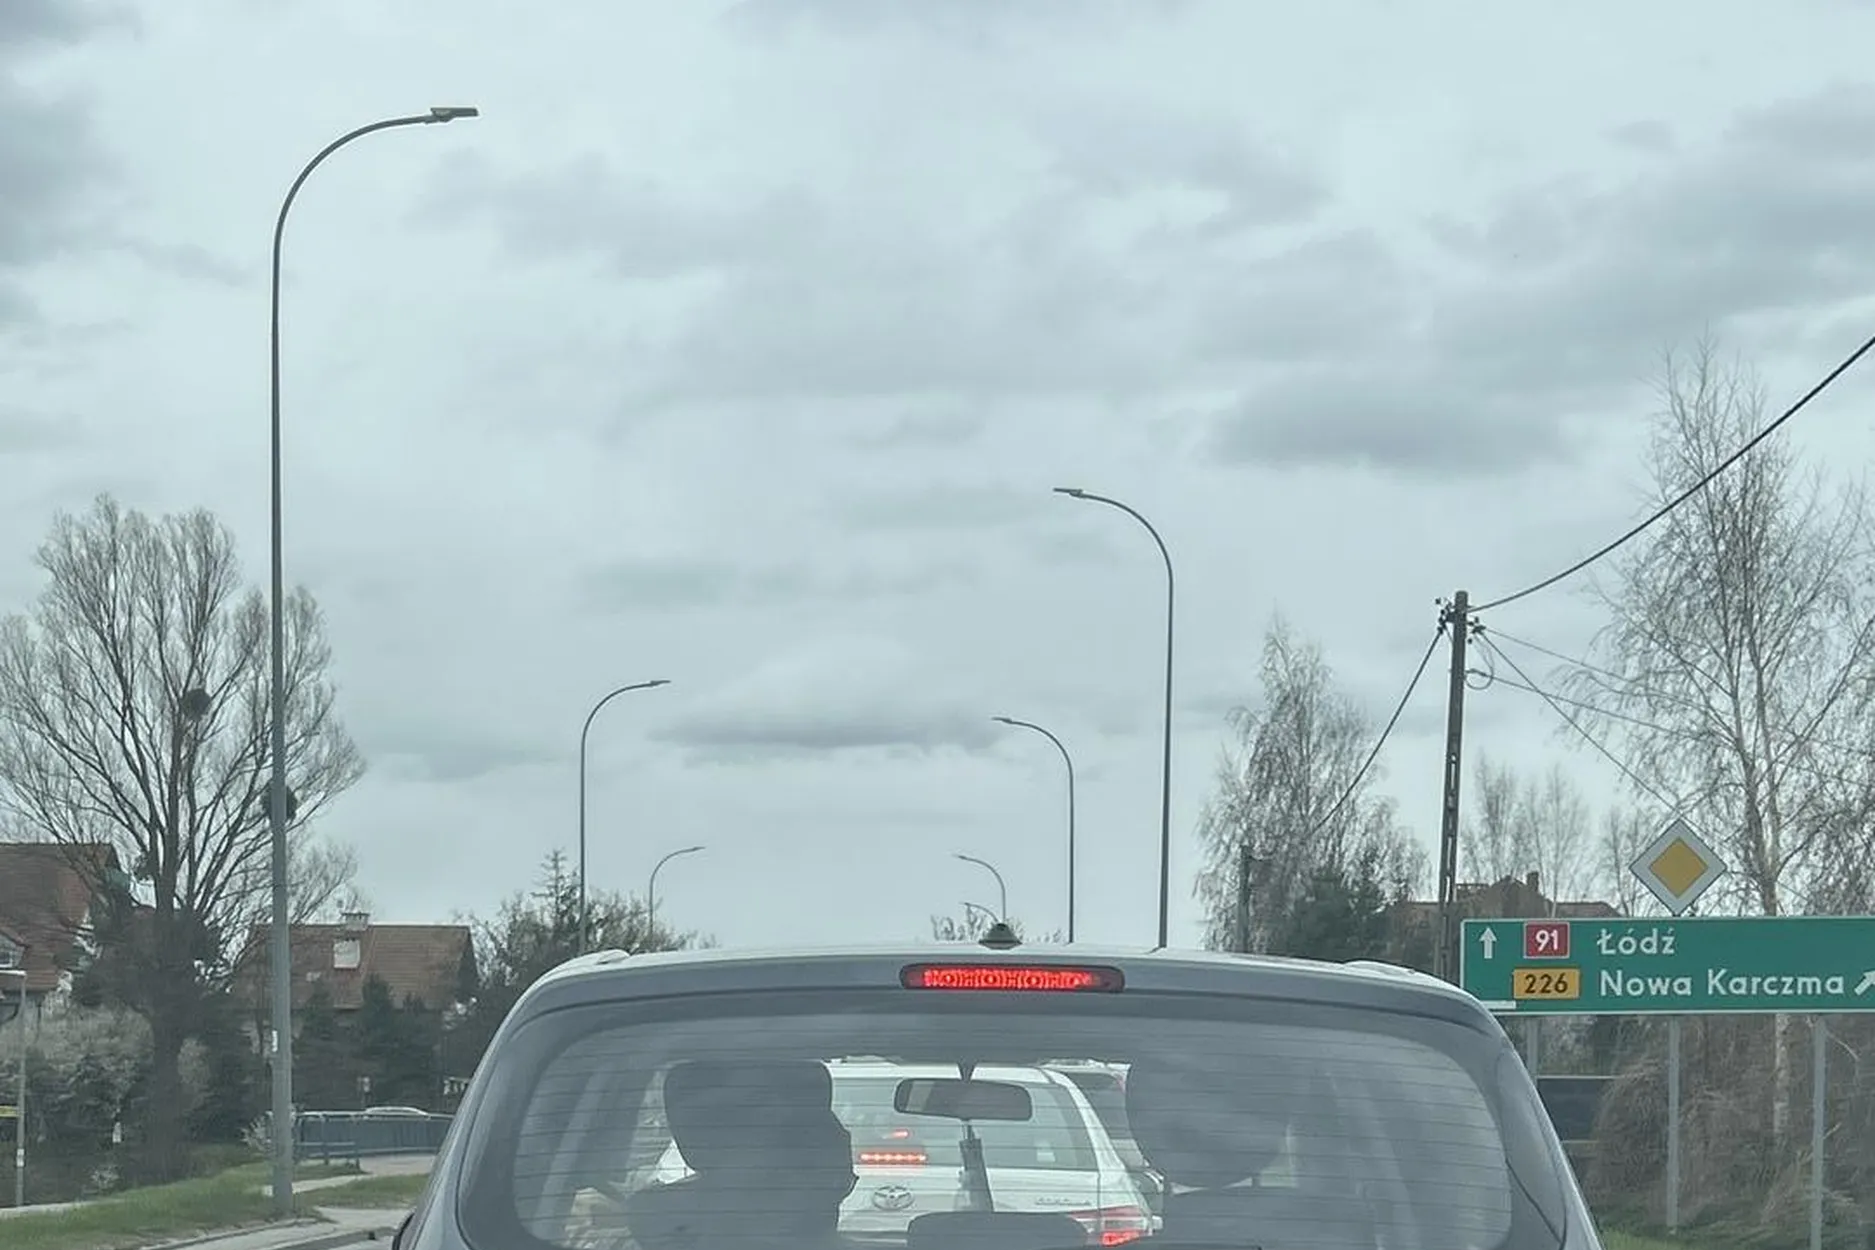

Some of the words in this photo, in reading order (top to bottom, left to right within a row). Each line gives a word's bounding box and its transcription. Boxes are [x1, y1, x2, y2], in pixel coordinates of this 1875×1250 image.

[1535, 929, 1560, 951] 91
[1597, 928, 1676, 956] Łódź
[1524, 973, 1568, 994] 226
[1600, 969, 1692, 997] Nowa
[1708, 968, 1844, 996] Karczma
